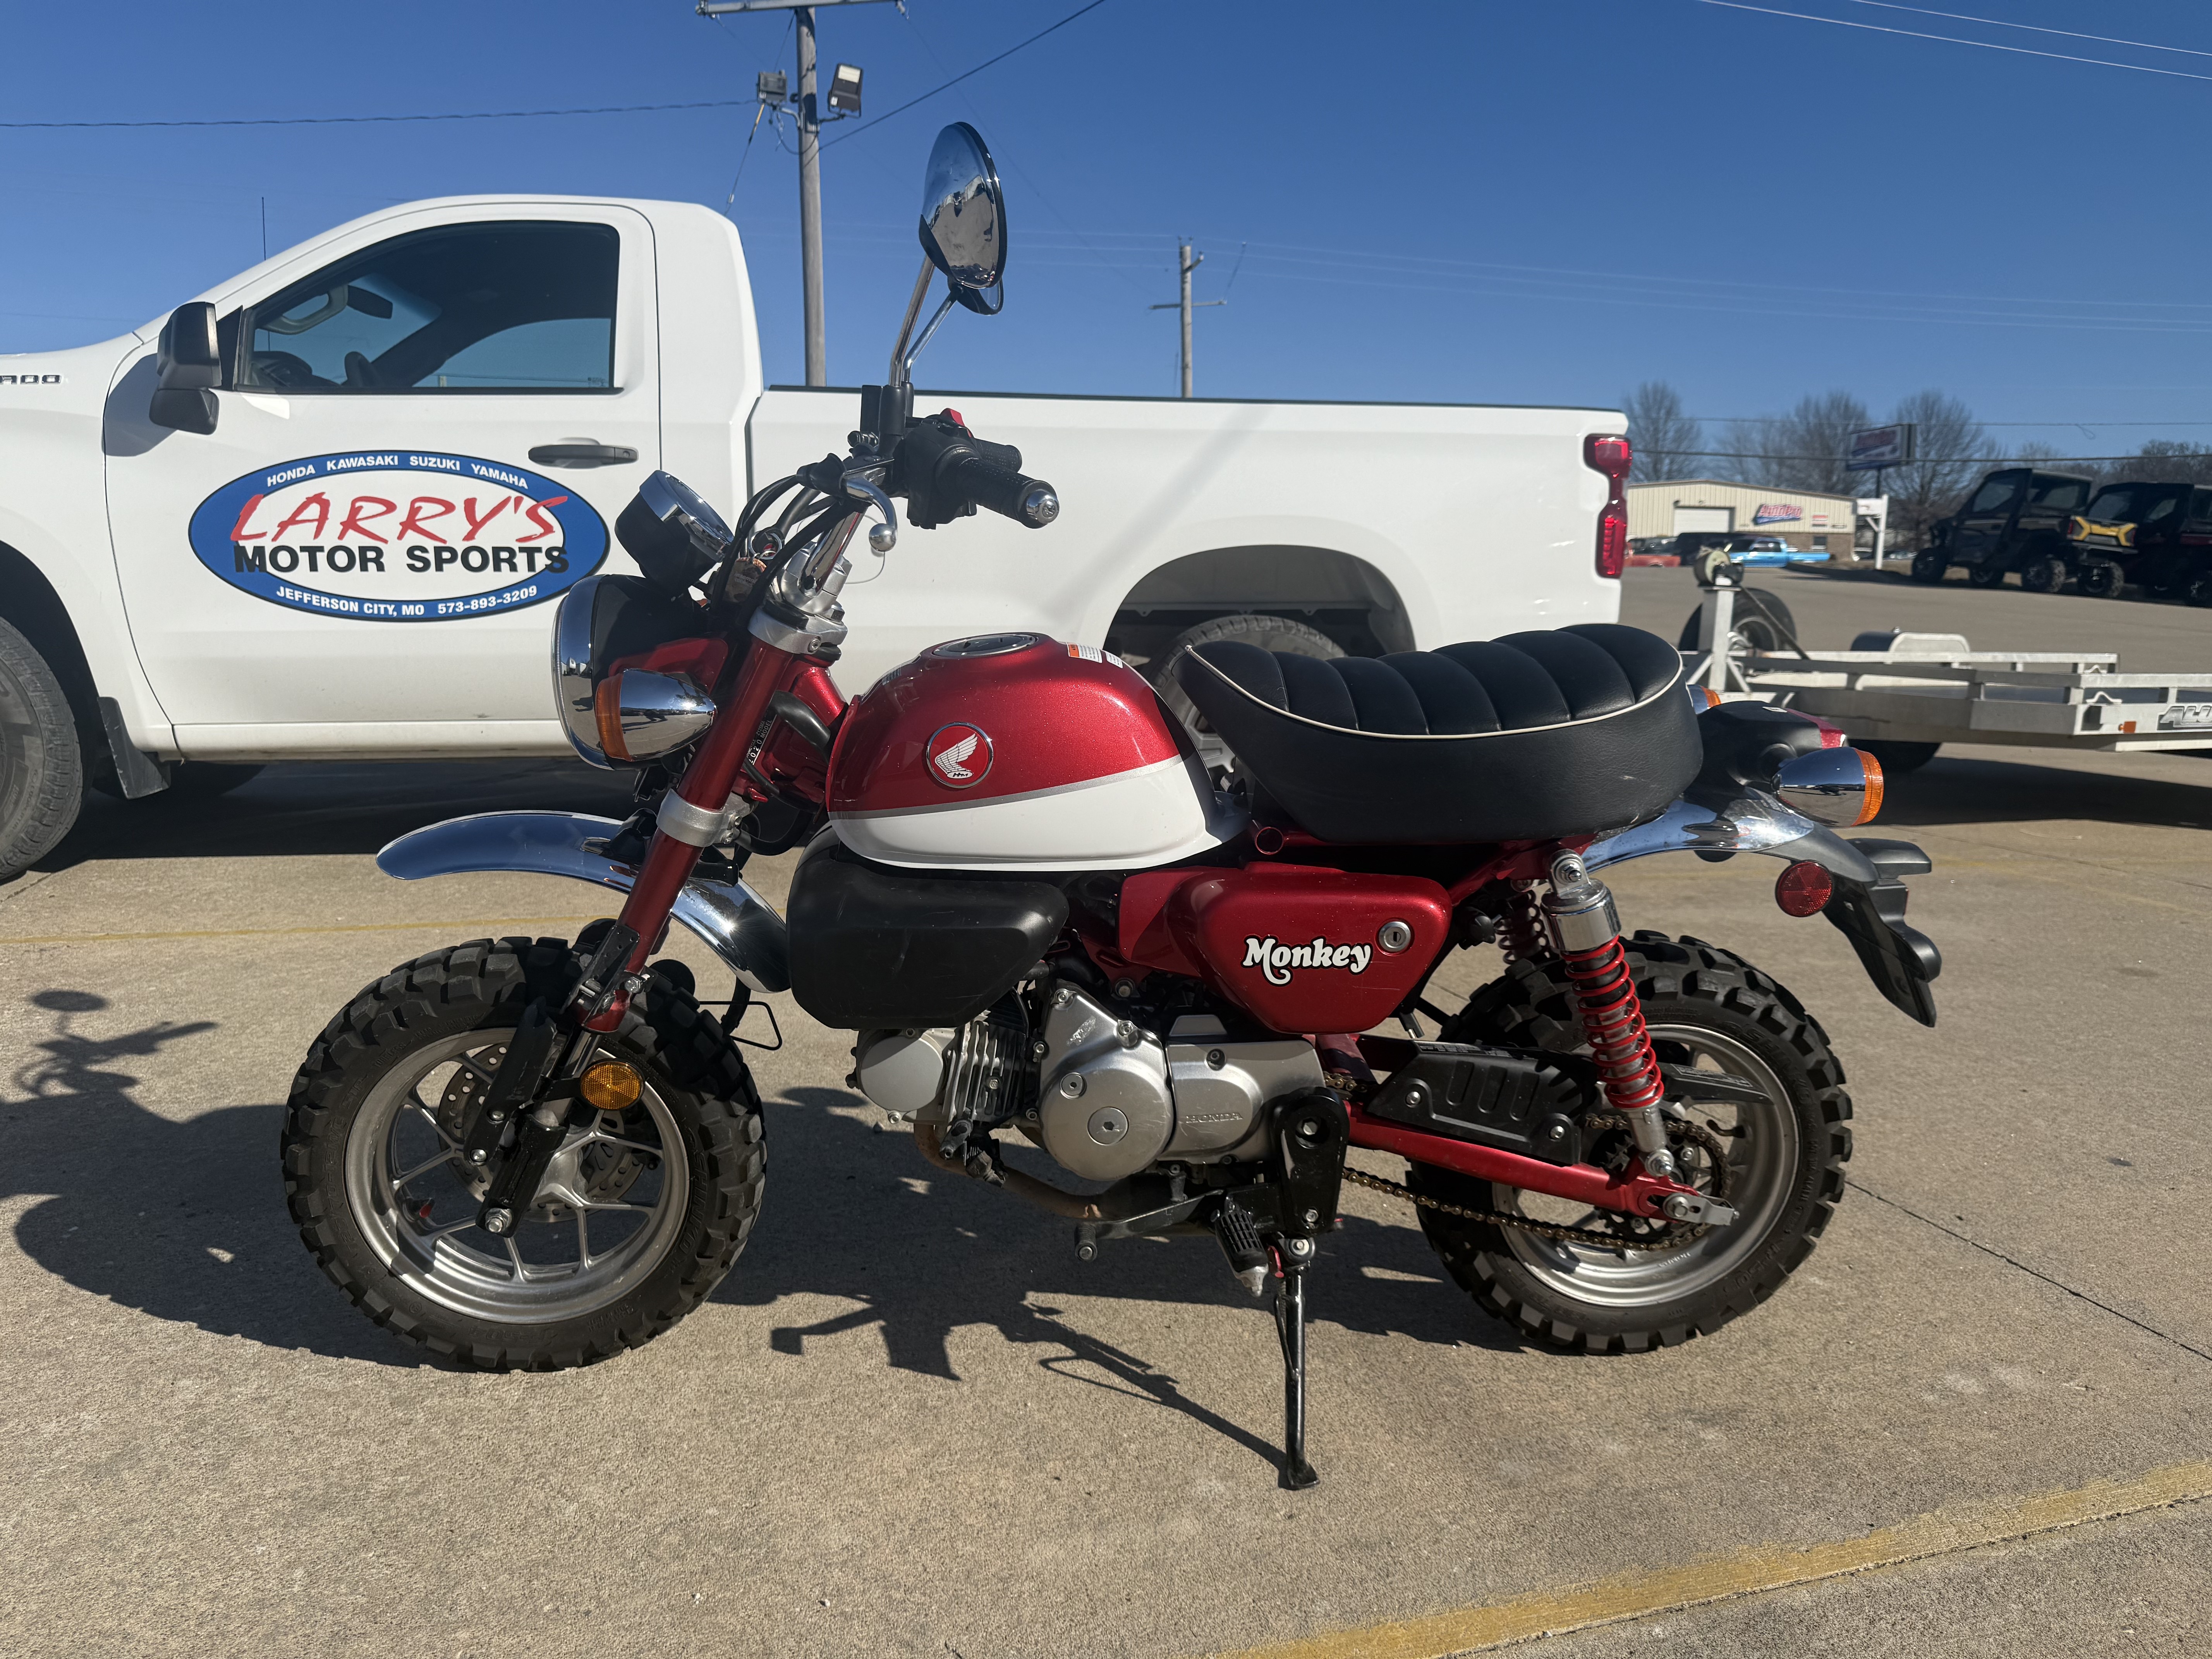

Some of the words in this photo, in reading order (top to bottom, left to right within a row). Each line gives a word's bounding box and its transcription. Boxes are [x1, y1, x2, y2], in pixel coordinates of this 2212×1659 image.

[267, 465, 316, 487] HONDA
[327, 455, 398, 471] KAWASAKI
[410, 456, 460, 471] SUZUKI
[471, 464, 528, 489] YAMAHA
[230, 492, 568, 544] LARRY'S
[234, 545, 386, 573] MOTOR
[406, 545, 569, 574] SPORTS
[276, 586, 358, 612] JEFFERSON
[364, 603, 397, 617] CITY,
[402, 604, 424, 615] MO
[438, 585, 537, 614] 573-893-3209
[760, 720, 772, 738] MODEL
[1242, 937, 1372, 985] Monkey
[1186, 1112, 1243, 1123] HONDA
